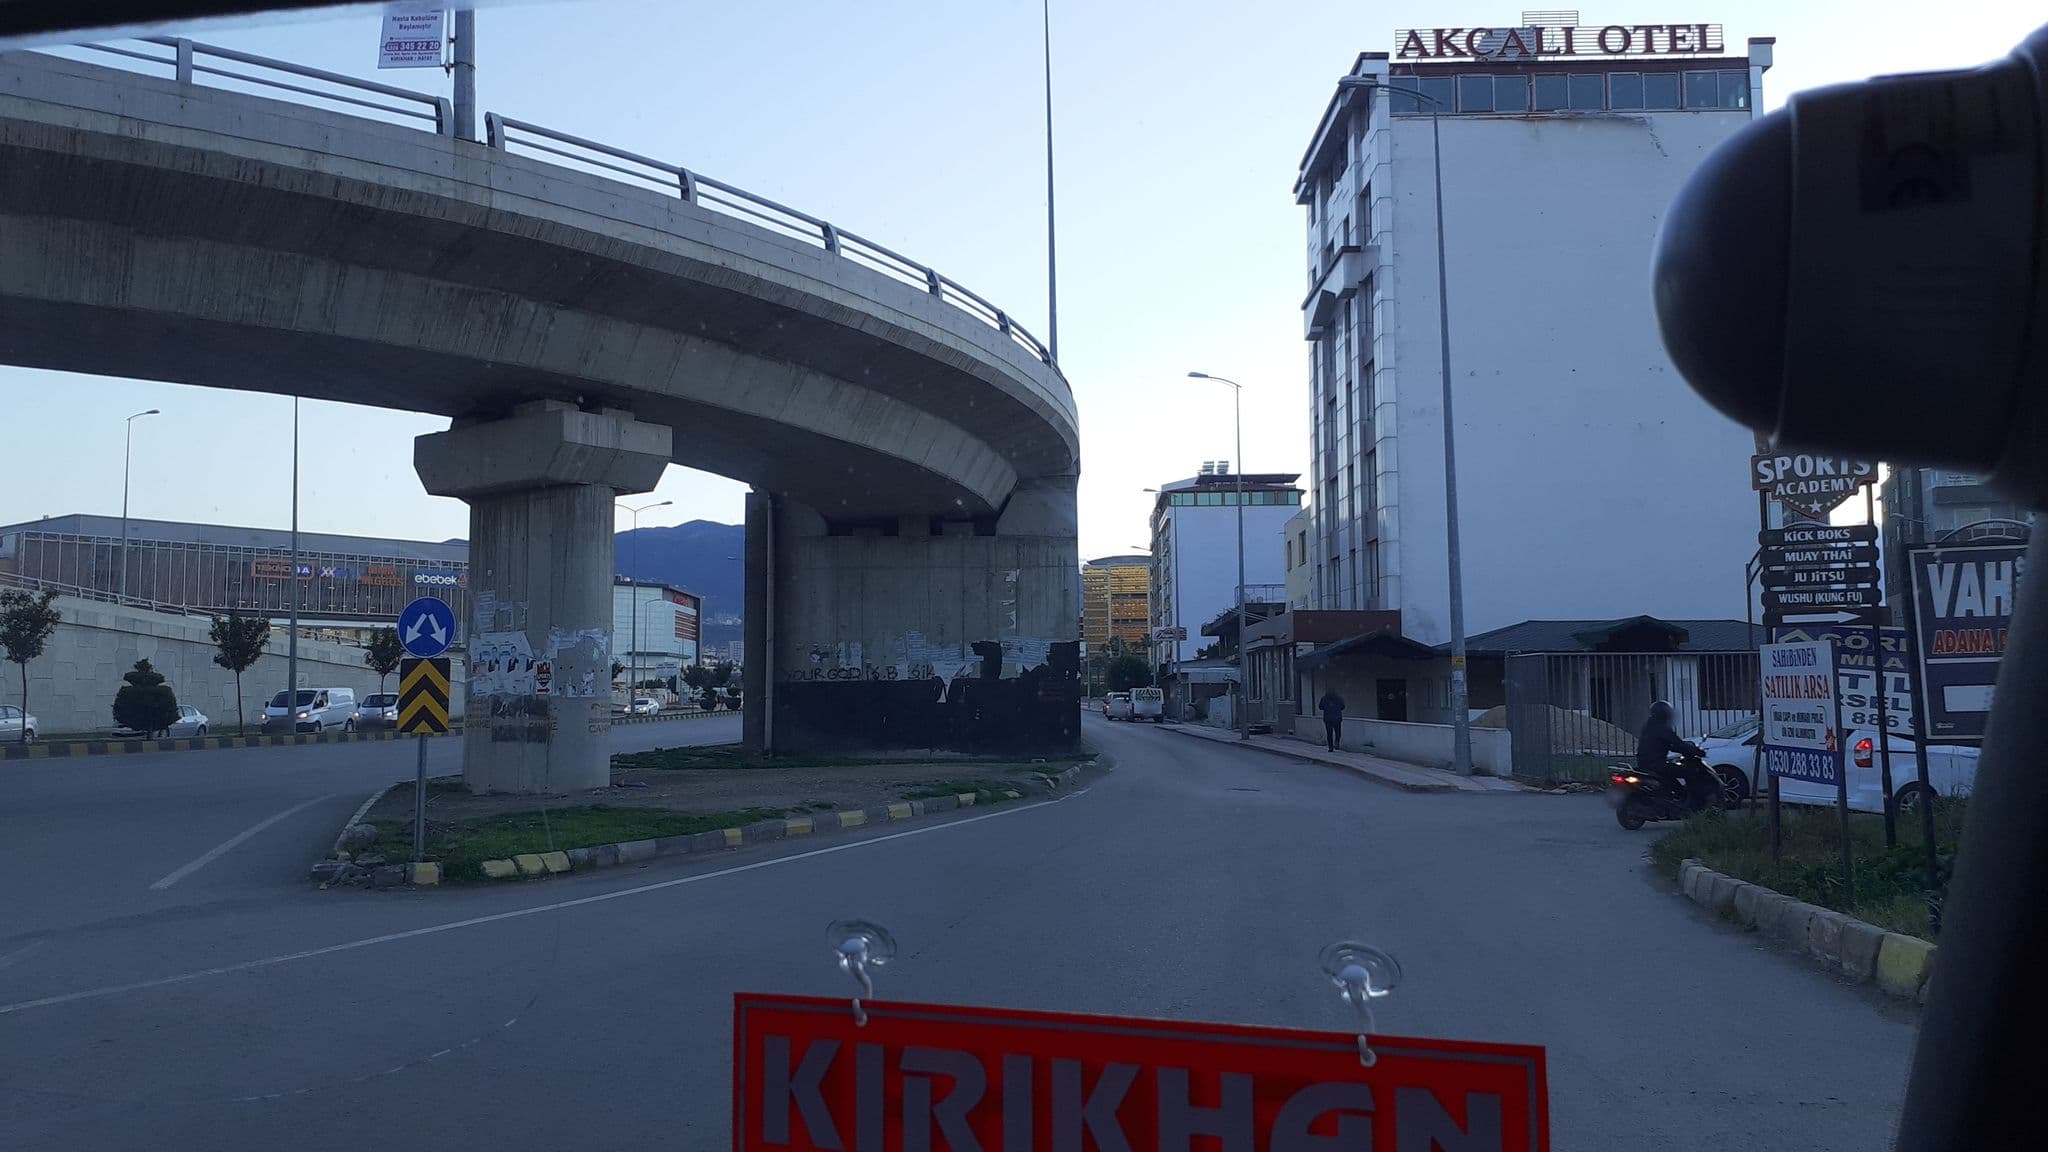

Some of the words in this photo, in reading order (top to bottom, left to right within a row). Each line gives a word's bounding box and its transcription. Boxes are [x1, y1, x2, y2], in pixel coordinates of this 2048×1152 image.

[400, 42, 415, 50] 345
[417, 42, 426, 50] 22
[429, 42, 439, 50] 20
[1600, 24, 1724, 55] OTEL
[1775, 477, 1856, 496] ACADEMY
[1817, 529, 1851, 540] BOKS
[1785, 551, 1821, 562] MUAY
[414, 573, 457, 585] ebebek
[1794, 572, 1807, 582] JU
[1778, 593, 1813, 604] WUSHU
[1815, 592, 1844, 604] (KUNG
[1847, 591, 1863, 603] FU)
[1932, 629, 1994, 654] ADANA
[1765, 675, 1802, 698] SATILIK
[1804, 674, 1831, 700] ARSA
[1769, 749, 1790, 773] 0530
[1790, 752, 1808, 776] 288
[1810, 754, 1821, 778] 33
[1823, 756, 1835, 780] 83
